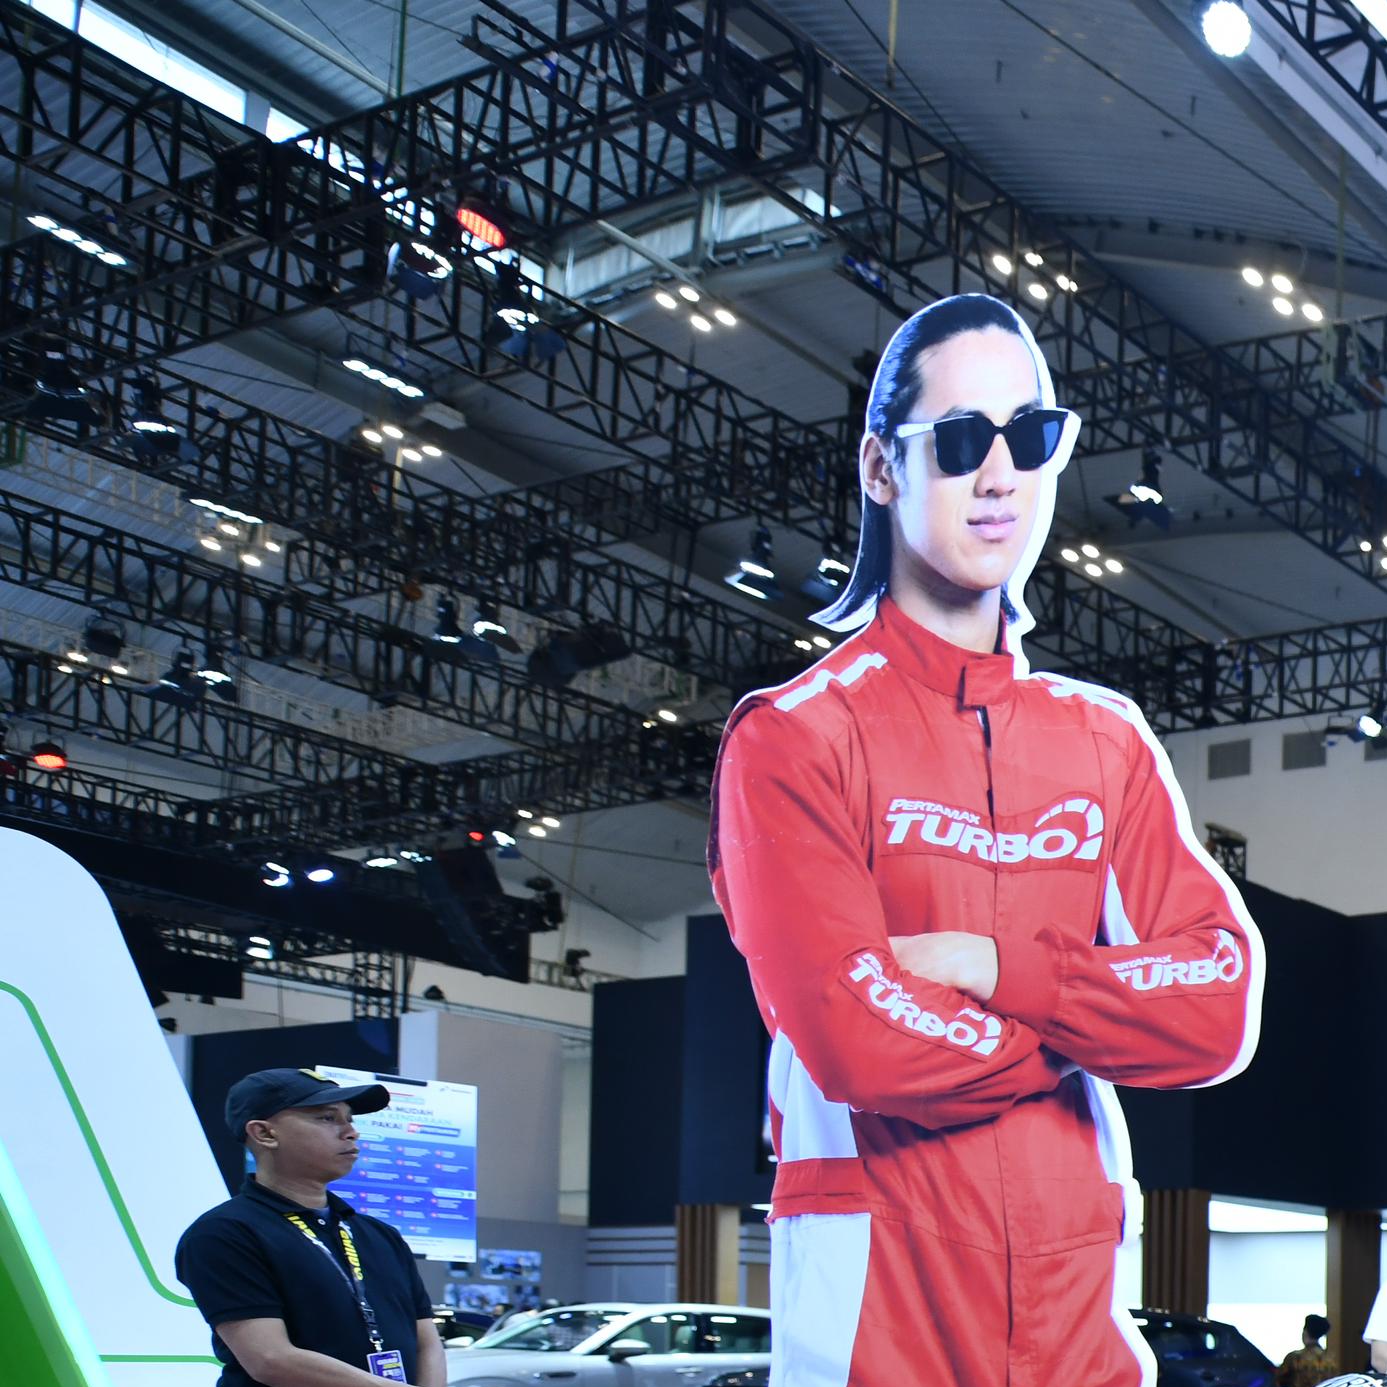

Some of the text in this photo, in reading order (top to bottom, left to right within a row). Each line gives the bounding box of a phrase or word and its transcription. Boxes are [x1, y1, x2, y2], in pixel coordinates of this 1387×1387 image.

[889, 798, 981, 825] PERTAMAX
[885, 813, 1078, 863] TURBO
[1115, 959, 1238, 991] TURBO
[849, 960, 979, 1047] TURBO
